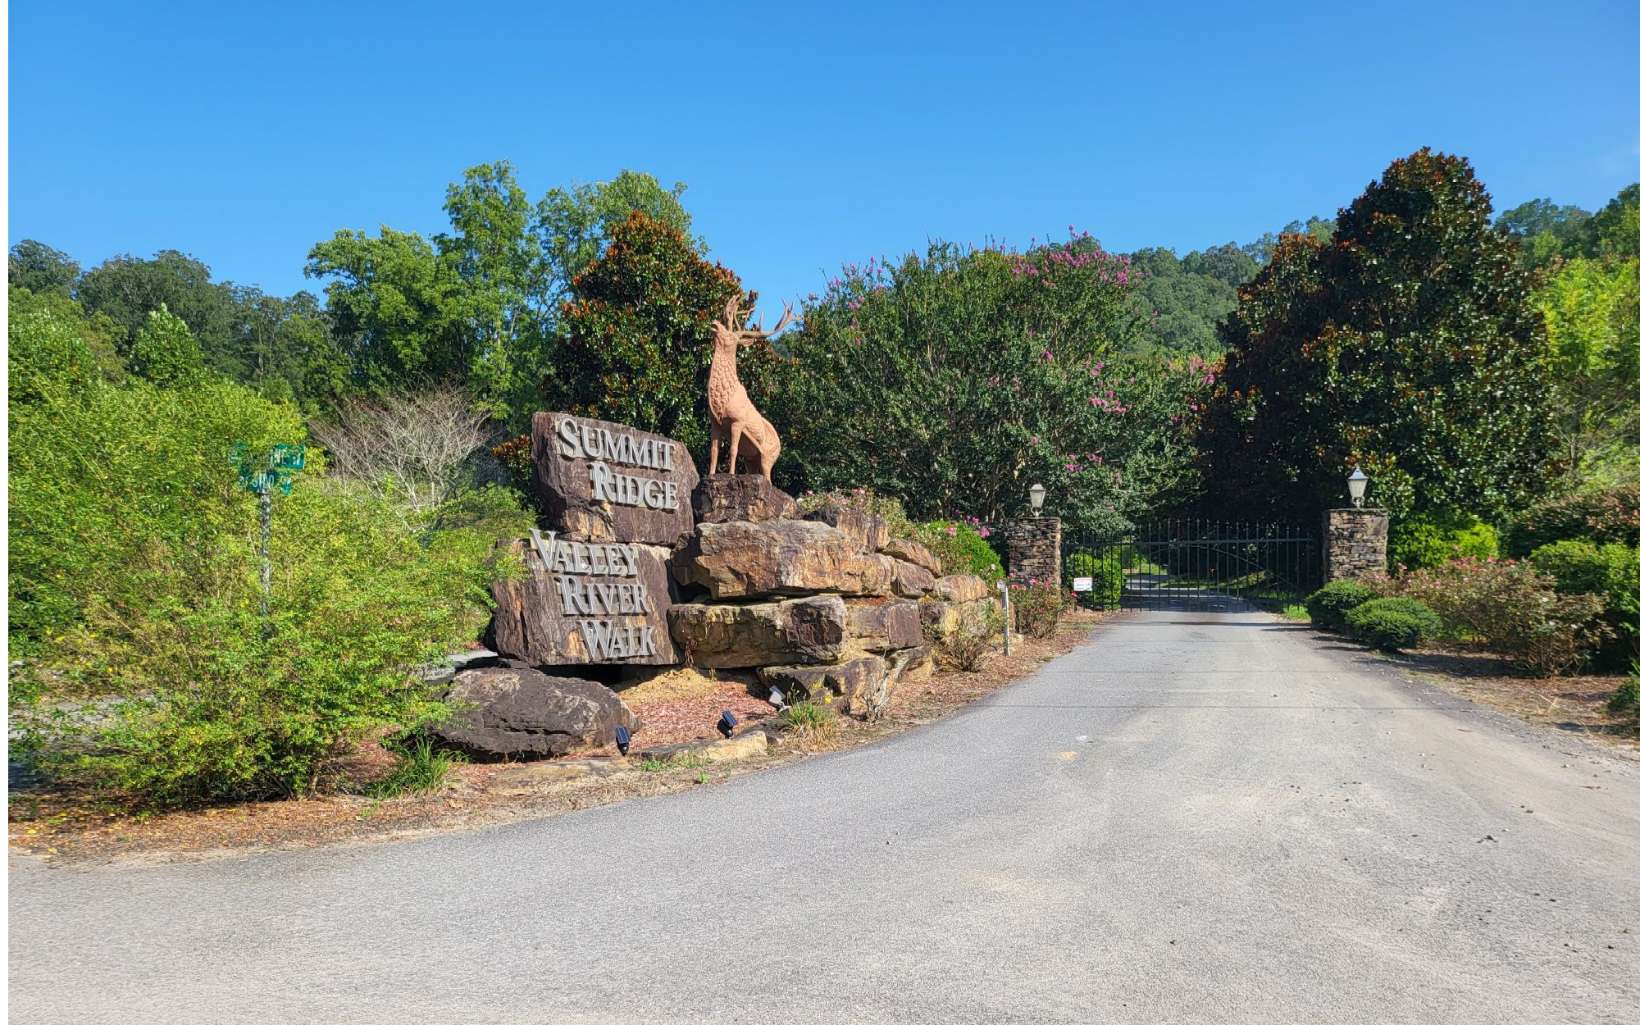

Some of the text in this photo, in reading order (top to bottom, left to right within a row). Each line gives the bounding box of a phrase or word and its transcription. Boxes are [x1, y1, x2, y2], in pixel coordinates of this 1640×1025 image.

[558, 418, 675, 470] SUMMIT
[590, 463, 679, 509] RIDGE
[529, 528, 638, 575] VALLEY
[556, 575, 651, 615] RIVER
[577, 620, 656, 658] WALK
